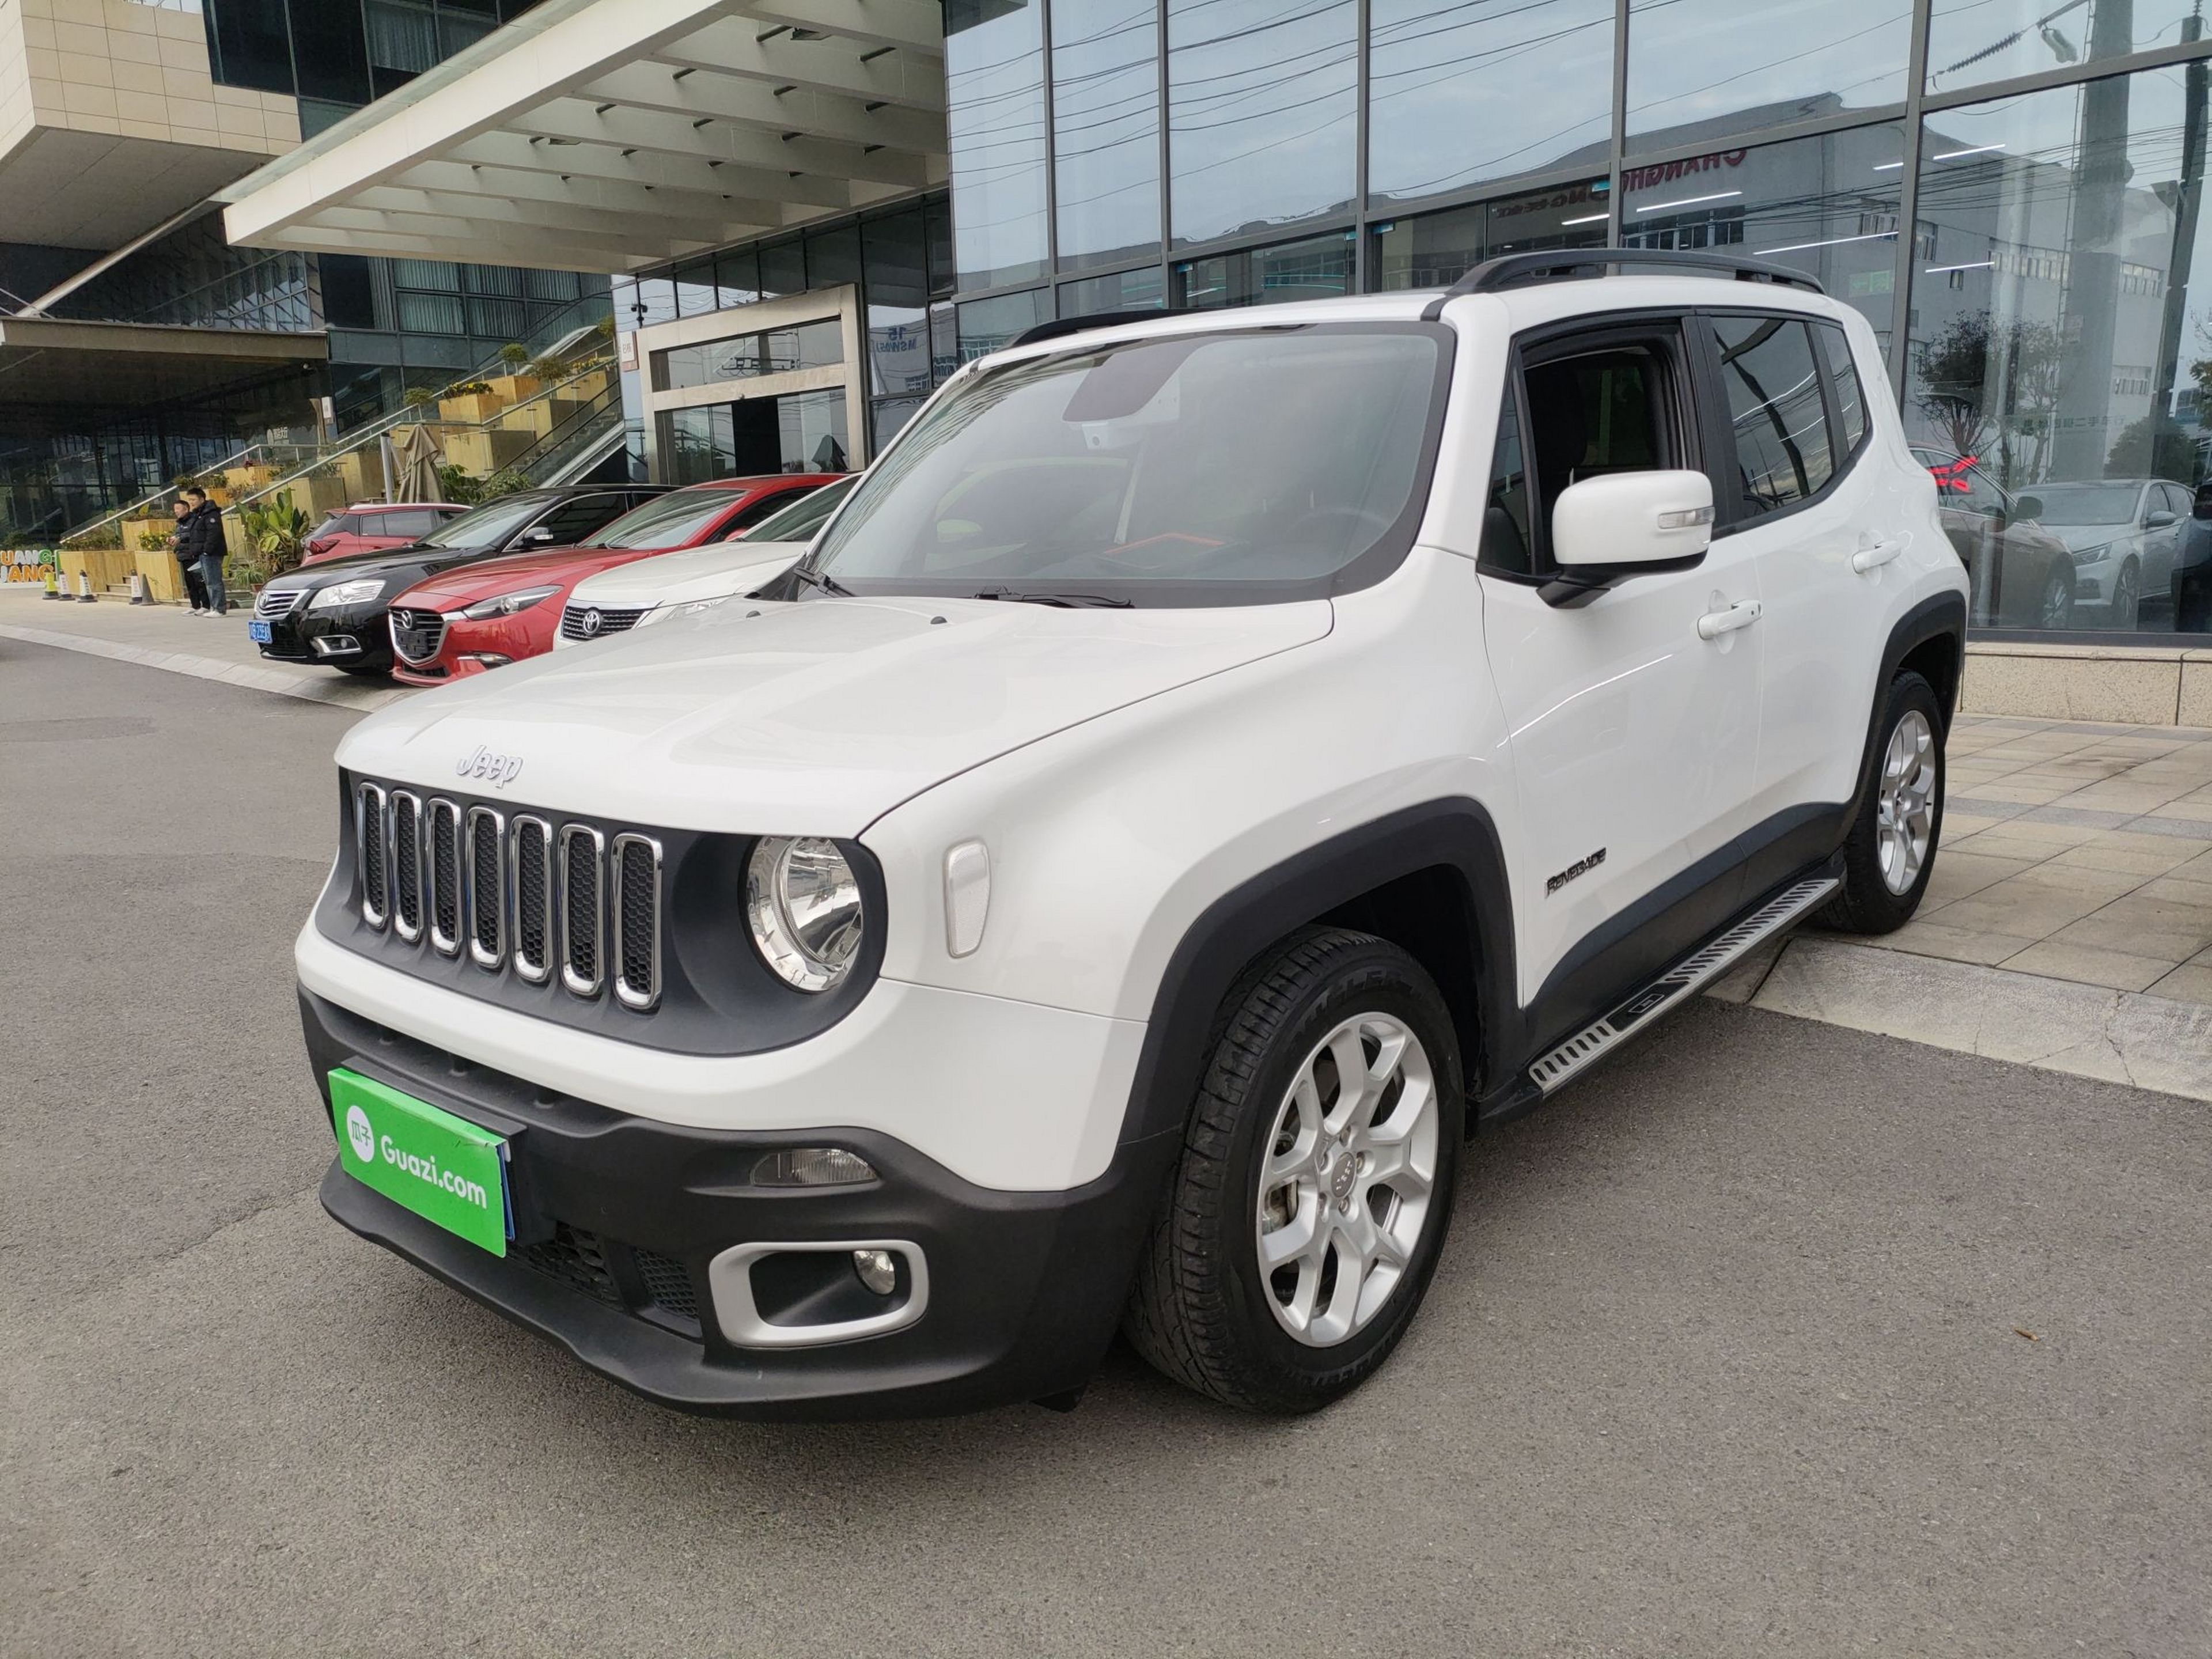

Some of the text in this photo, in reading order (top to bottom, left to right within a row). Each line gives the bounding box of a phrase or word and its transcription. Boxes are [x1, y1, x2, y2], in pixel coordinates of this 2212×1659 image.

[457, 745, 523, 789] Jeep
[351, 1120, 371, 1147] 瓜子
[380, 1135, 487, 1210] Guazi.com
